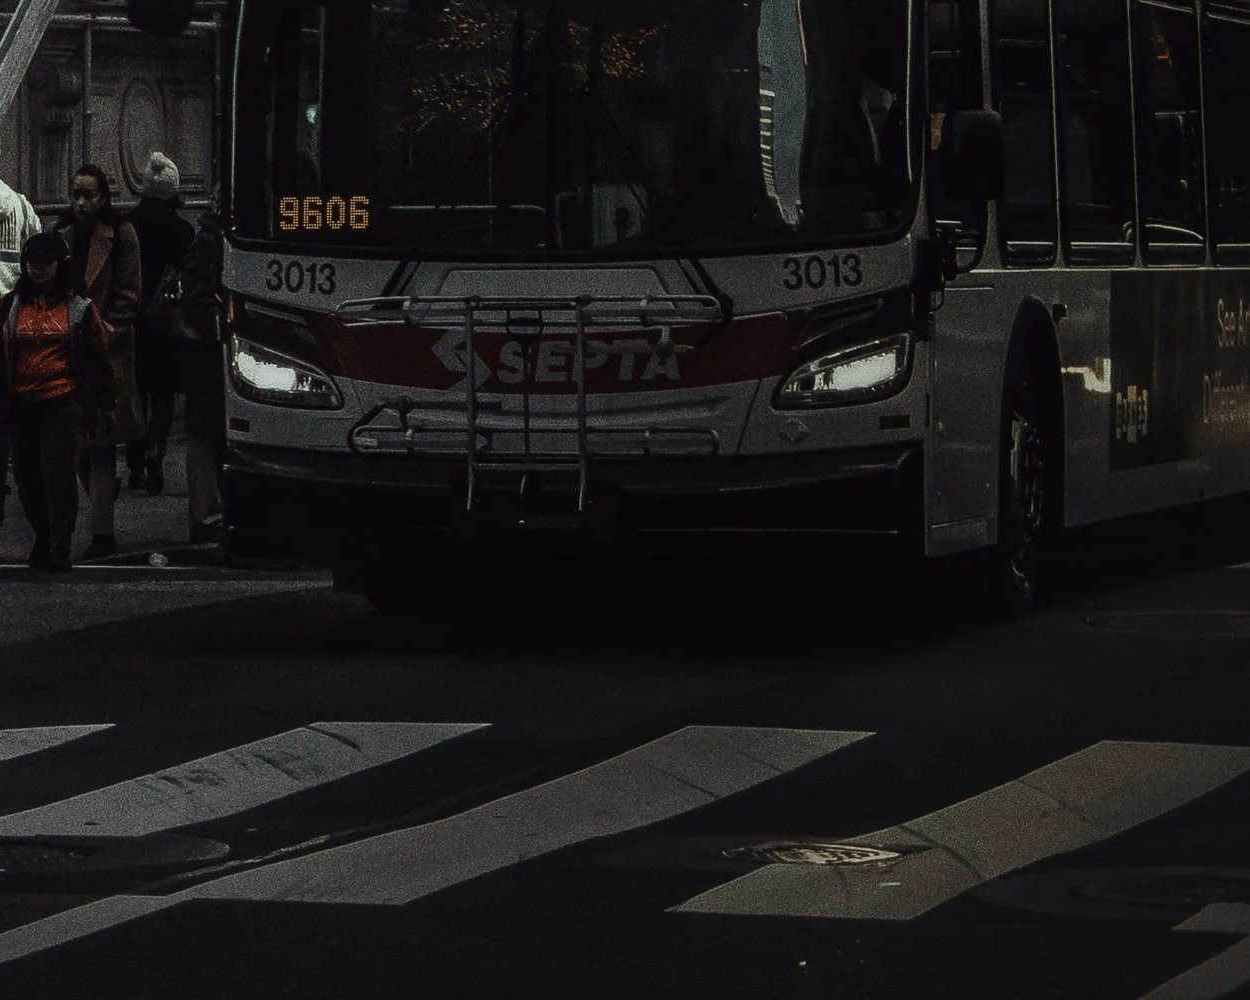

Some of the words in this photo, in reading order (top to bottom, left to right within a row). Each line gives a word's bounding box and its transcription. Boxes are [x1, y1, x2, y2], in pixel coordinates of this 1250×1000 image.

[279, 196, 372, 230] 9606
[265, 259, 336, 295] 3013
[782, 253, 863, 291] 3013
[496, 338, 682, 384] SEPTA
